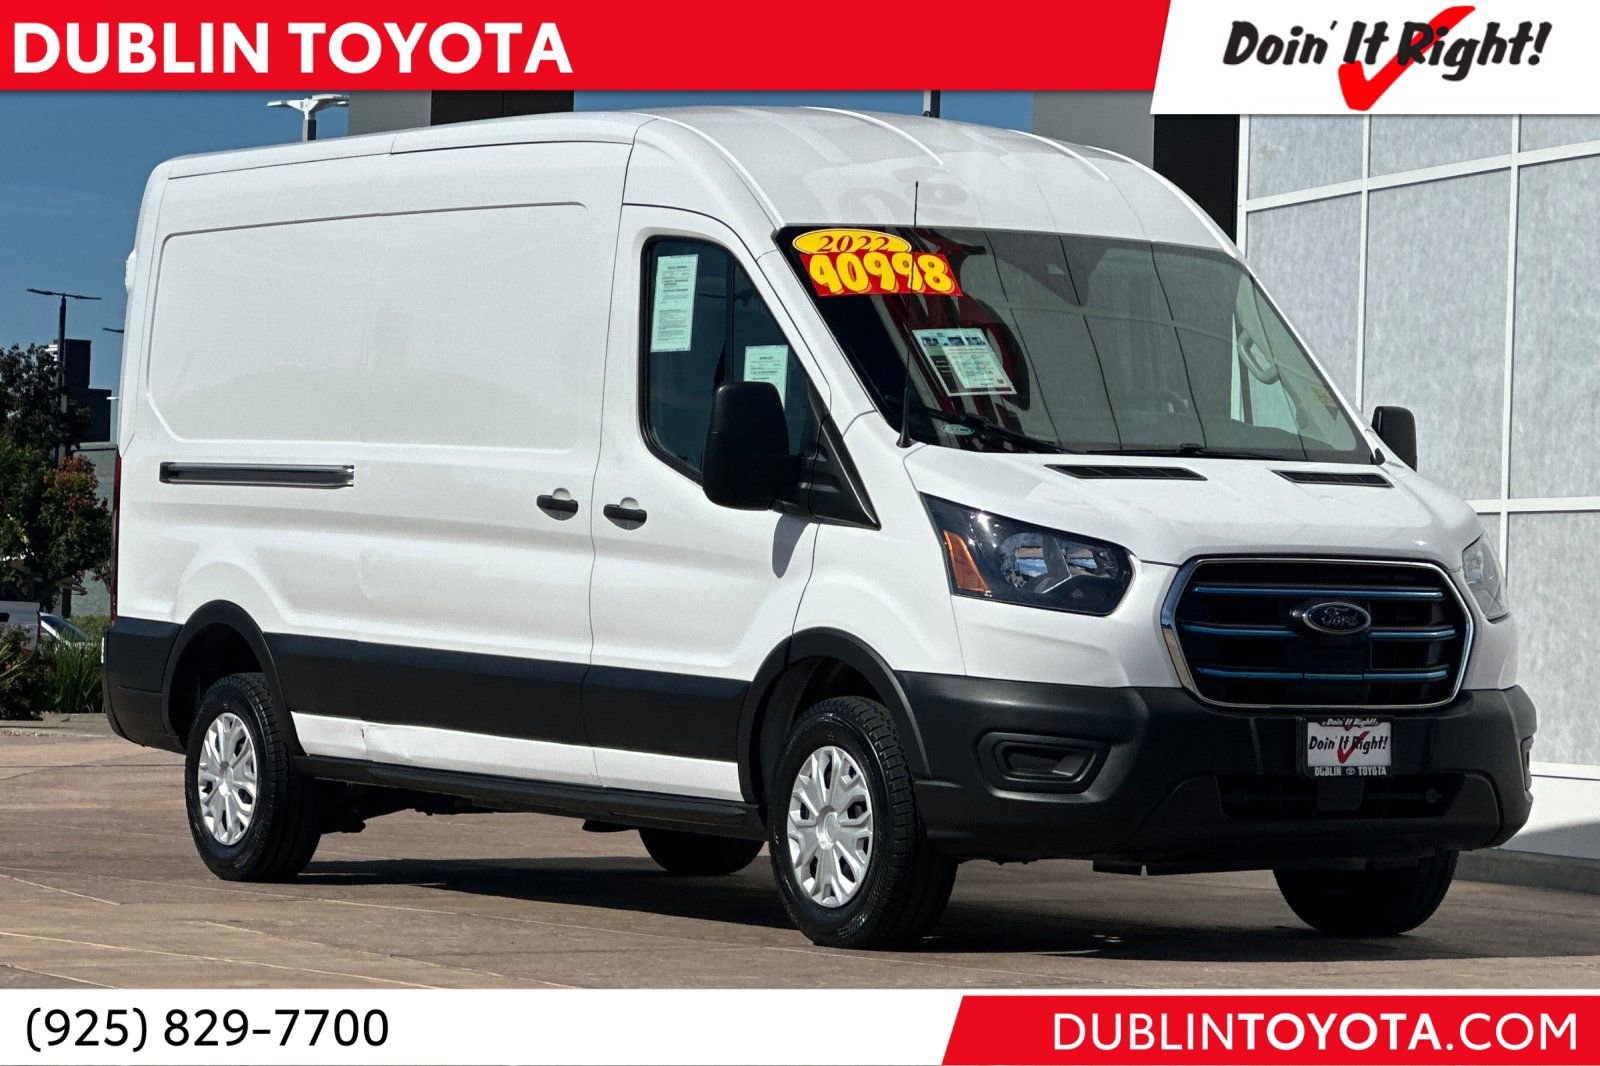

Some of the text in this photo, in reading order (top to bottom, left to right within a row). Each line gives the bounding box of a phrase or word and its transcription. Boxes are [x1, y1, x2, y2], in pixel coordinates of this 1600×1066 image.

[818, 235, 890, 252] 2022
[809, 252, 955, 294] 40998
[1321, 606, 1358, 627] Ford
[1339, 735, 1350, 750] It
[1352, 735, 1389, 754] Right!
[1314, 766, 1387, 776] DUBLIN TOYOTA
